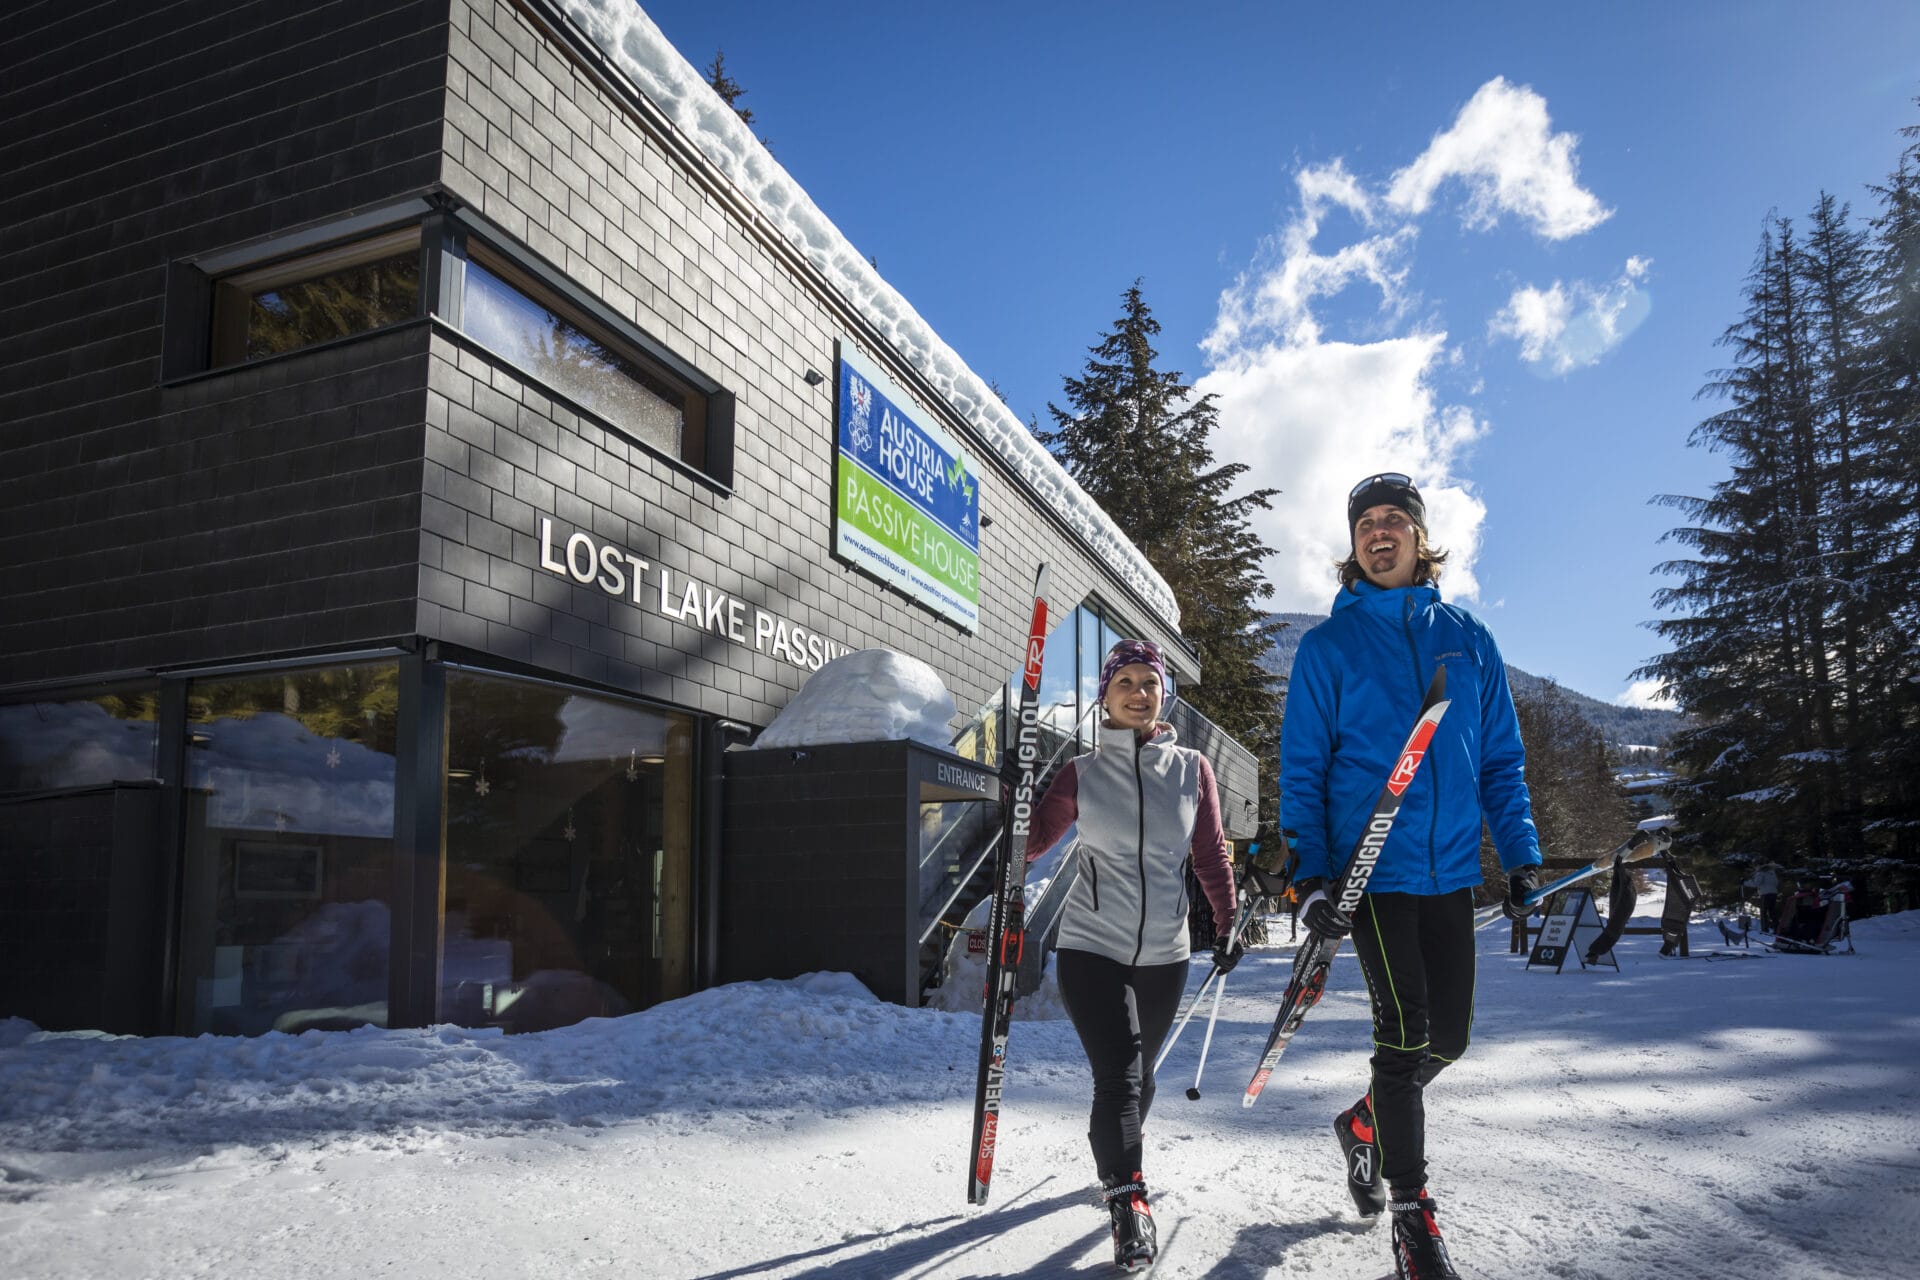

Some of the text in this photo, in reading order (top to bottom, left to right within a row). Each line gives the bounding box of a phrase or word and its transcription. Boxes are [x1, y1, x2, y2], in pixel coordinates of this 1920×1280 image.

[879, 435, 934, 504] HOUSE
[880, 408, 945, 485] AUSTRIA
[847, 476, 975, 593] PASSIVE HOUSE
[541, 517, 850, 671] LOST LAKE PASSI
[937, 762, 986, 792] ENTRANCE
[1012, 693, 1040, 836] ROSSIGNOL
[1337, 806, 1400, 912] ROSSIGNOL
[969, 938, 985, 949] CLOS
[986, 890, 999, 966] ROSSIGNOL
[984, 1059, 1006, 1112] DELTA
